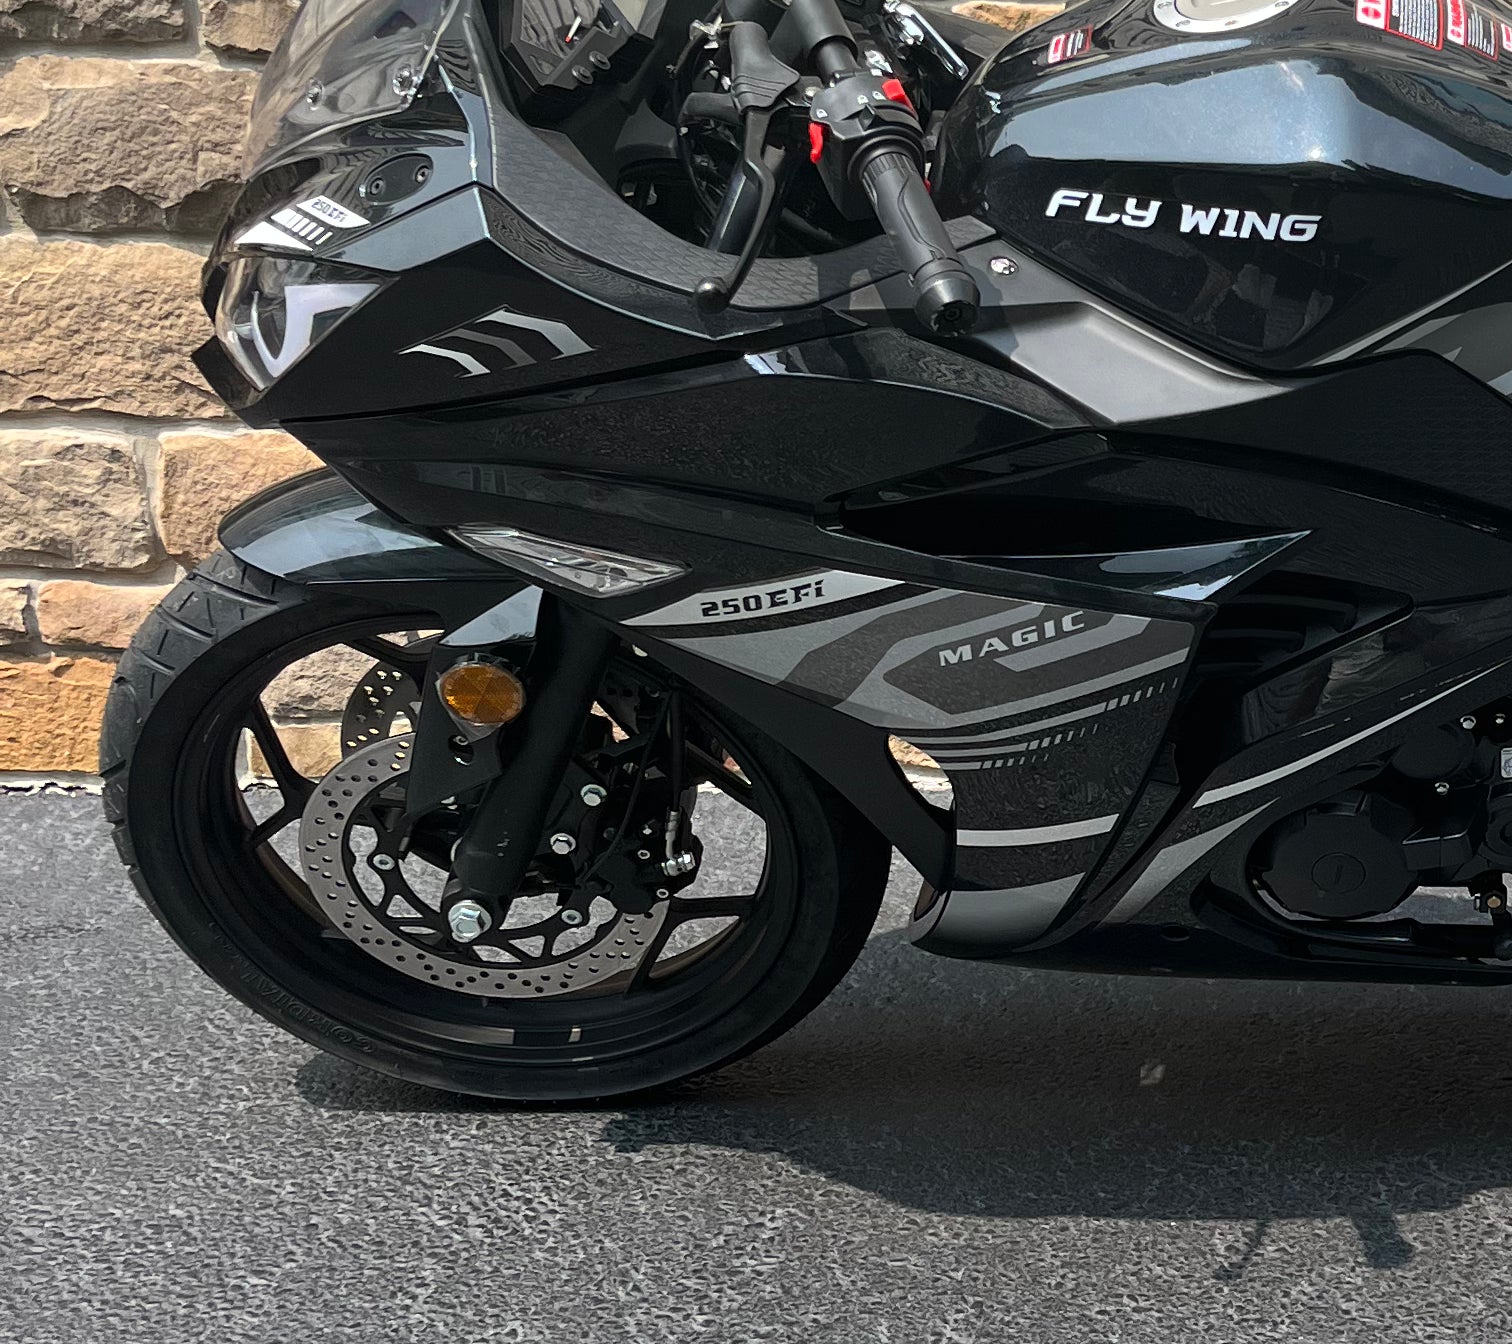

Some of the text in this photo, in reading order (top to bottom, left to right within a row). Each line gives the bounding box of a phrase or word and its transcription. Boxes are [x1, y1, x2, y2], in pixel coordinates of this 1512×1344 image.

[1044, 187, 1324, 243] FLY WING
[938, 609, 1087, 667] MAGIC
